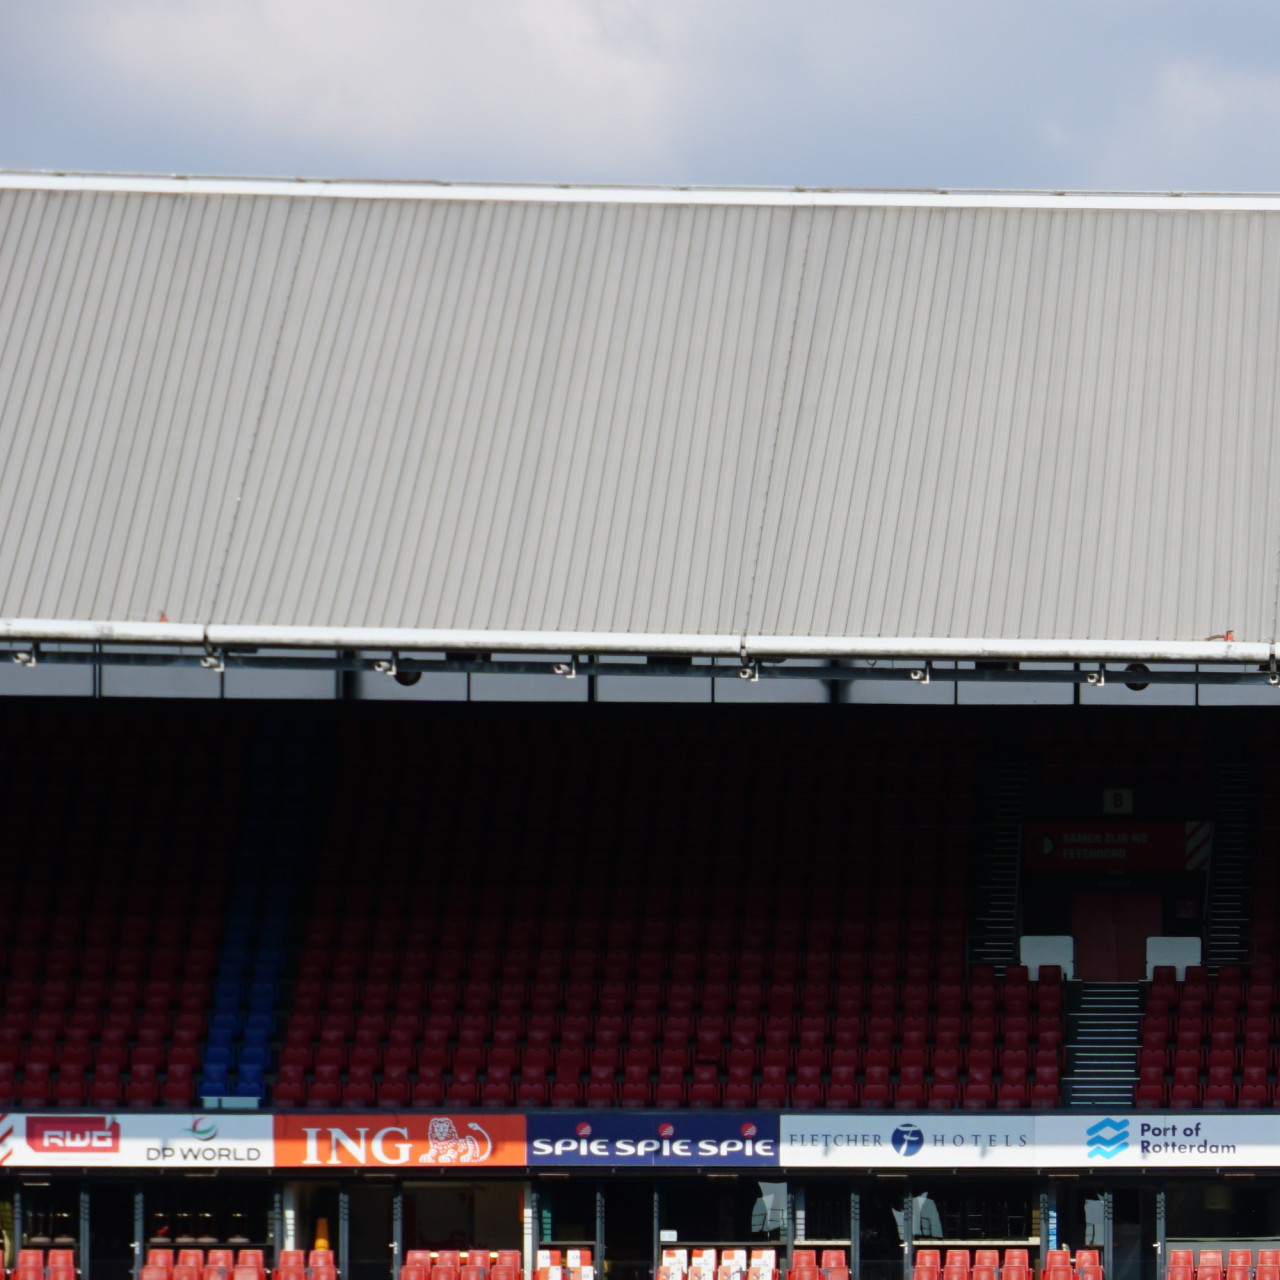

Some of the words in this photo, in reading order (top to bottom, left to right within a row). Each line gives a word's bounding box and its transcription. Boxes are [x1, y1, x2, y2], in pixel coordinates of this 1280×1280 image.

[1113, 793, 1124, 808] B
[1062, 832, 1101, 844] SAMEN
[1131, 833, 1148, 844] WE
[1062, 848, 1126, 859] FEYENOORD
[1141, 1122, 1177, 1138] Port
[1182, 1122, 1202, 1138] of
[43, 1130, 113, 1147] RWG
[301, 1127, 413, 1165] ING
[789, 1132, 882, 1148] FLETCHER
[932, 1133, 1028, 1147] HOTELS
[146, 1147, 175, 1161] DP
[180, 1147, 260, 1161] WORLD
[532, 1138, 609, 1156] SPIE
[615, 1138, 692, 1156] SPIE
[698, 1138, 775, 1156] SPIE
[1141, 1139, 1237, 1155] Rotterdam
